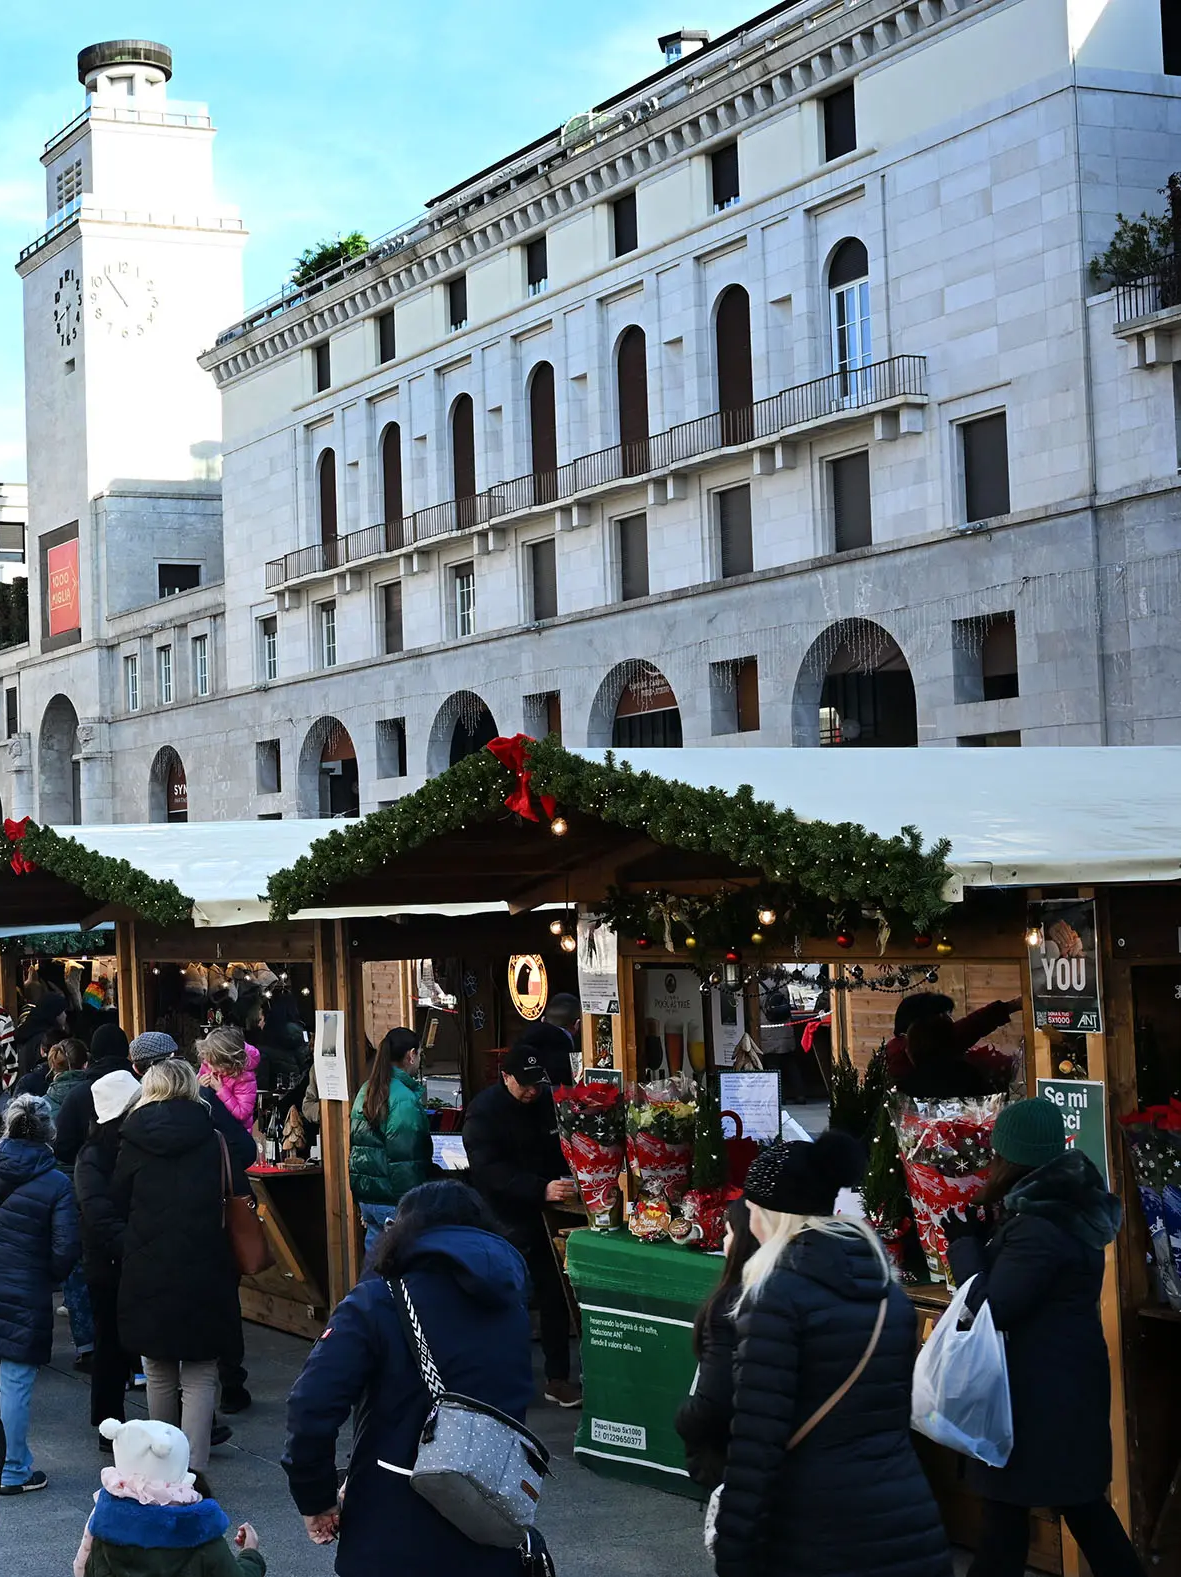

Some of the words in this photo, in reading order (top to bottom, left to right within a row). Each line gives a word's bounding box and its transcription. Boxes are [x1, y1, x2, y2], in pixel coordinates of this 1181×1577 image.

[52, 572, 69, 588] 1000
[1041, 958, 1086, 991] YOU
[1077, 1015, 1097, 1028] ANT
[1044, 1086, 1065, 1106] Se
[1068, 1088, 1088, 1108] mi
[613, 1331, 623, 1339] ANT
[622, 1427, 641, 1436] 5x1000
